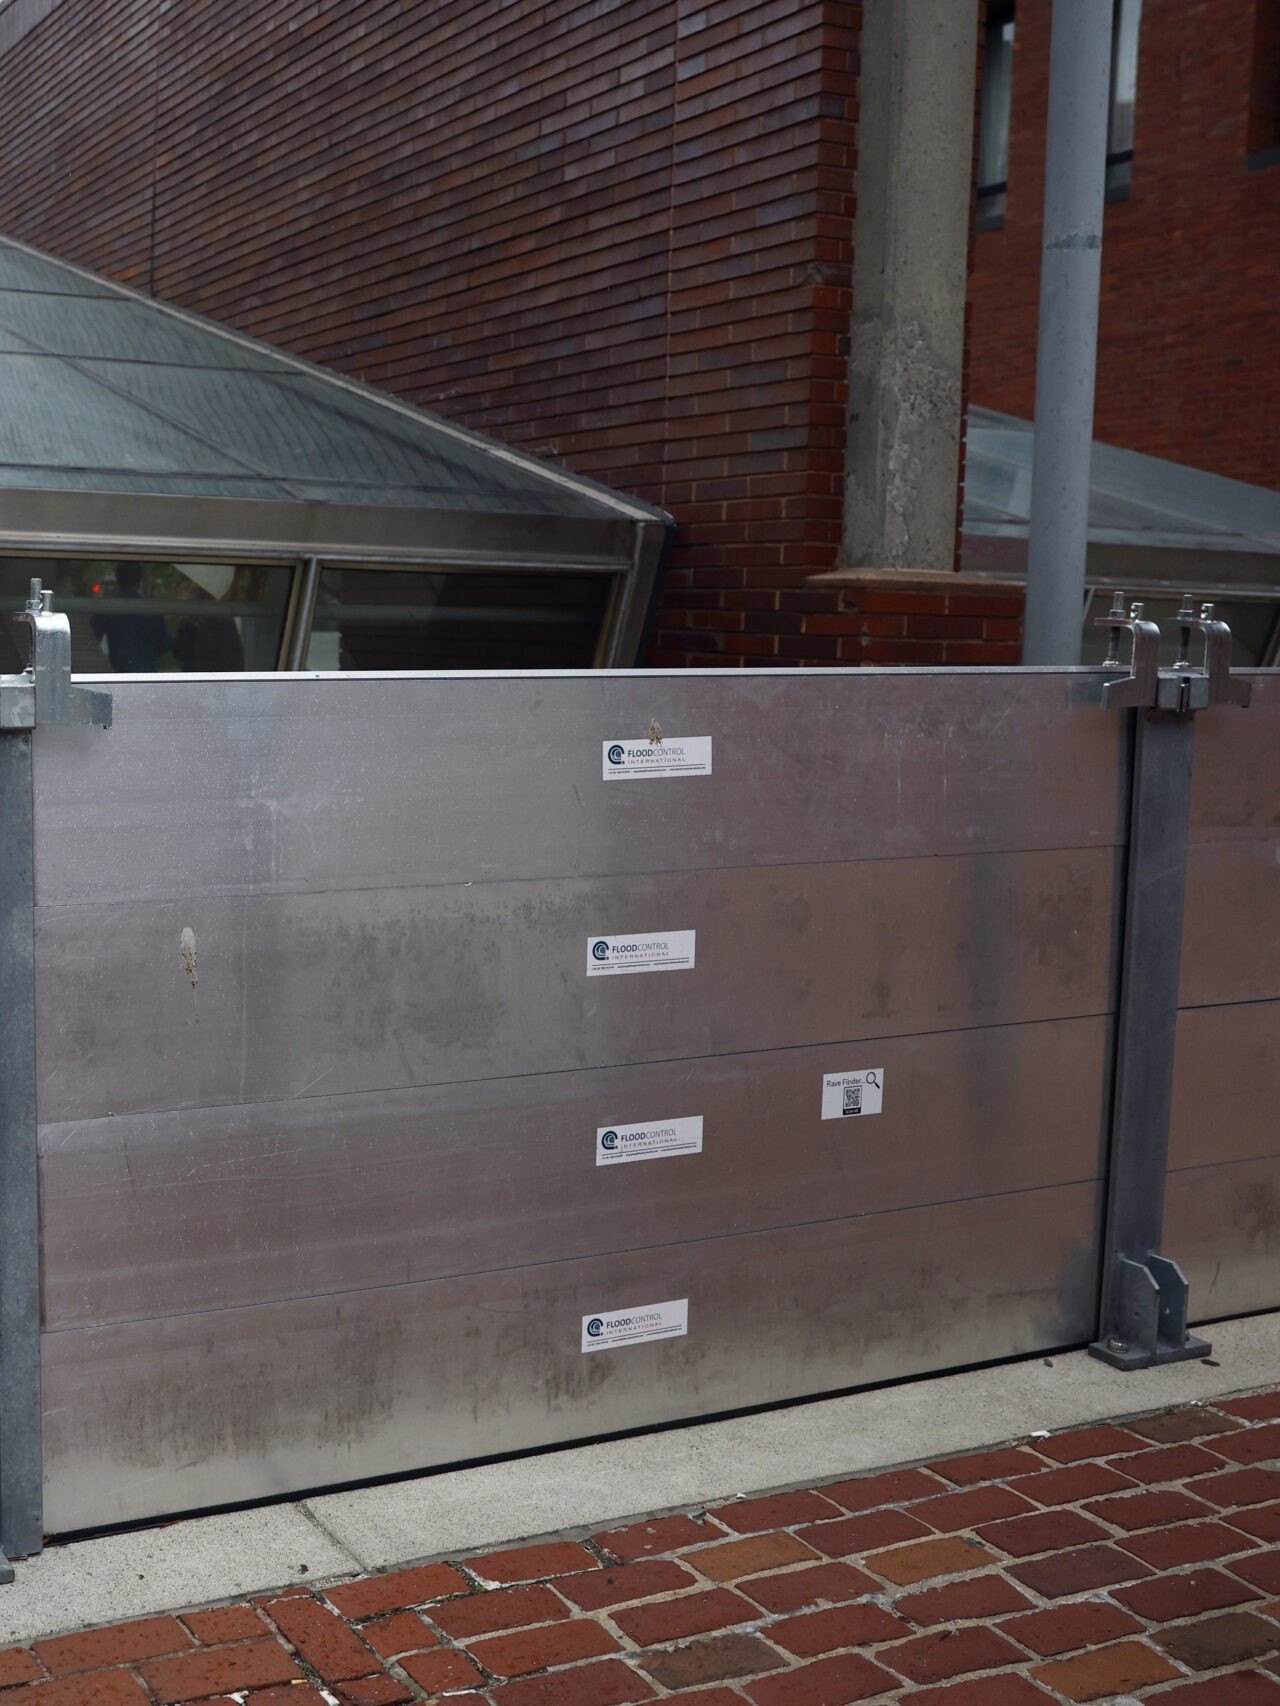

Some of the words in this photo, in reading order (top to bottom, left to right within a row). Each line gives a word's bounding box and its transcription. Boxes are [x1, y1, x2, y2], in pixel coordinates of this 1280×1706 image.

[628, 757, 685, 765] INTERNATIONAL
[612, 951, 669, 960] INTERNATIONAL
[621, 1138, 677, 1150] INTERNATIONAL
[606, 1322, 663, 1336] INTERNATIONAL
